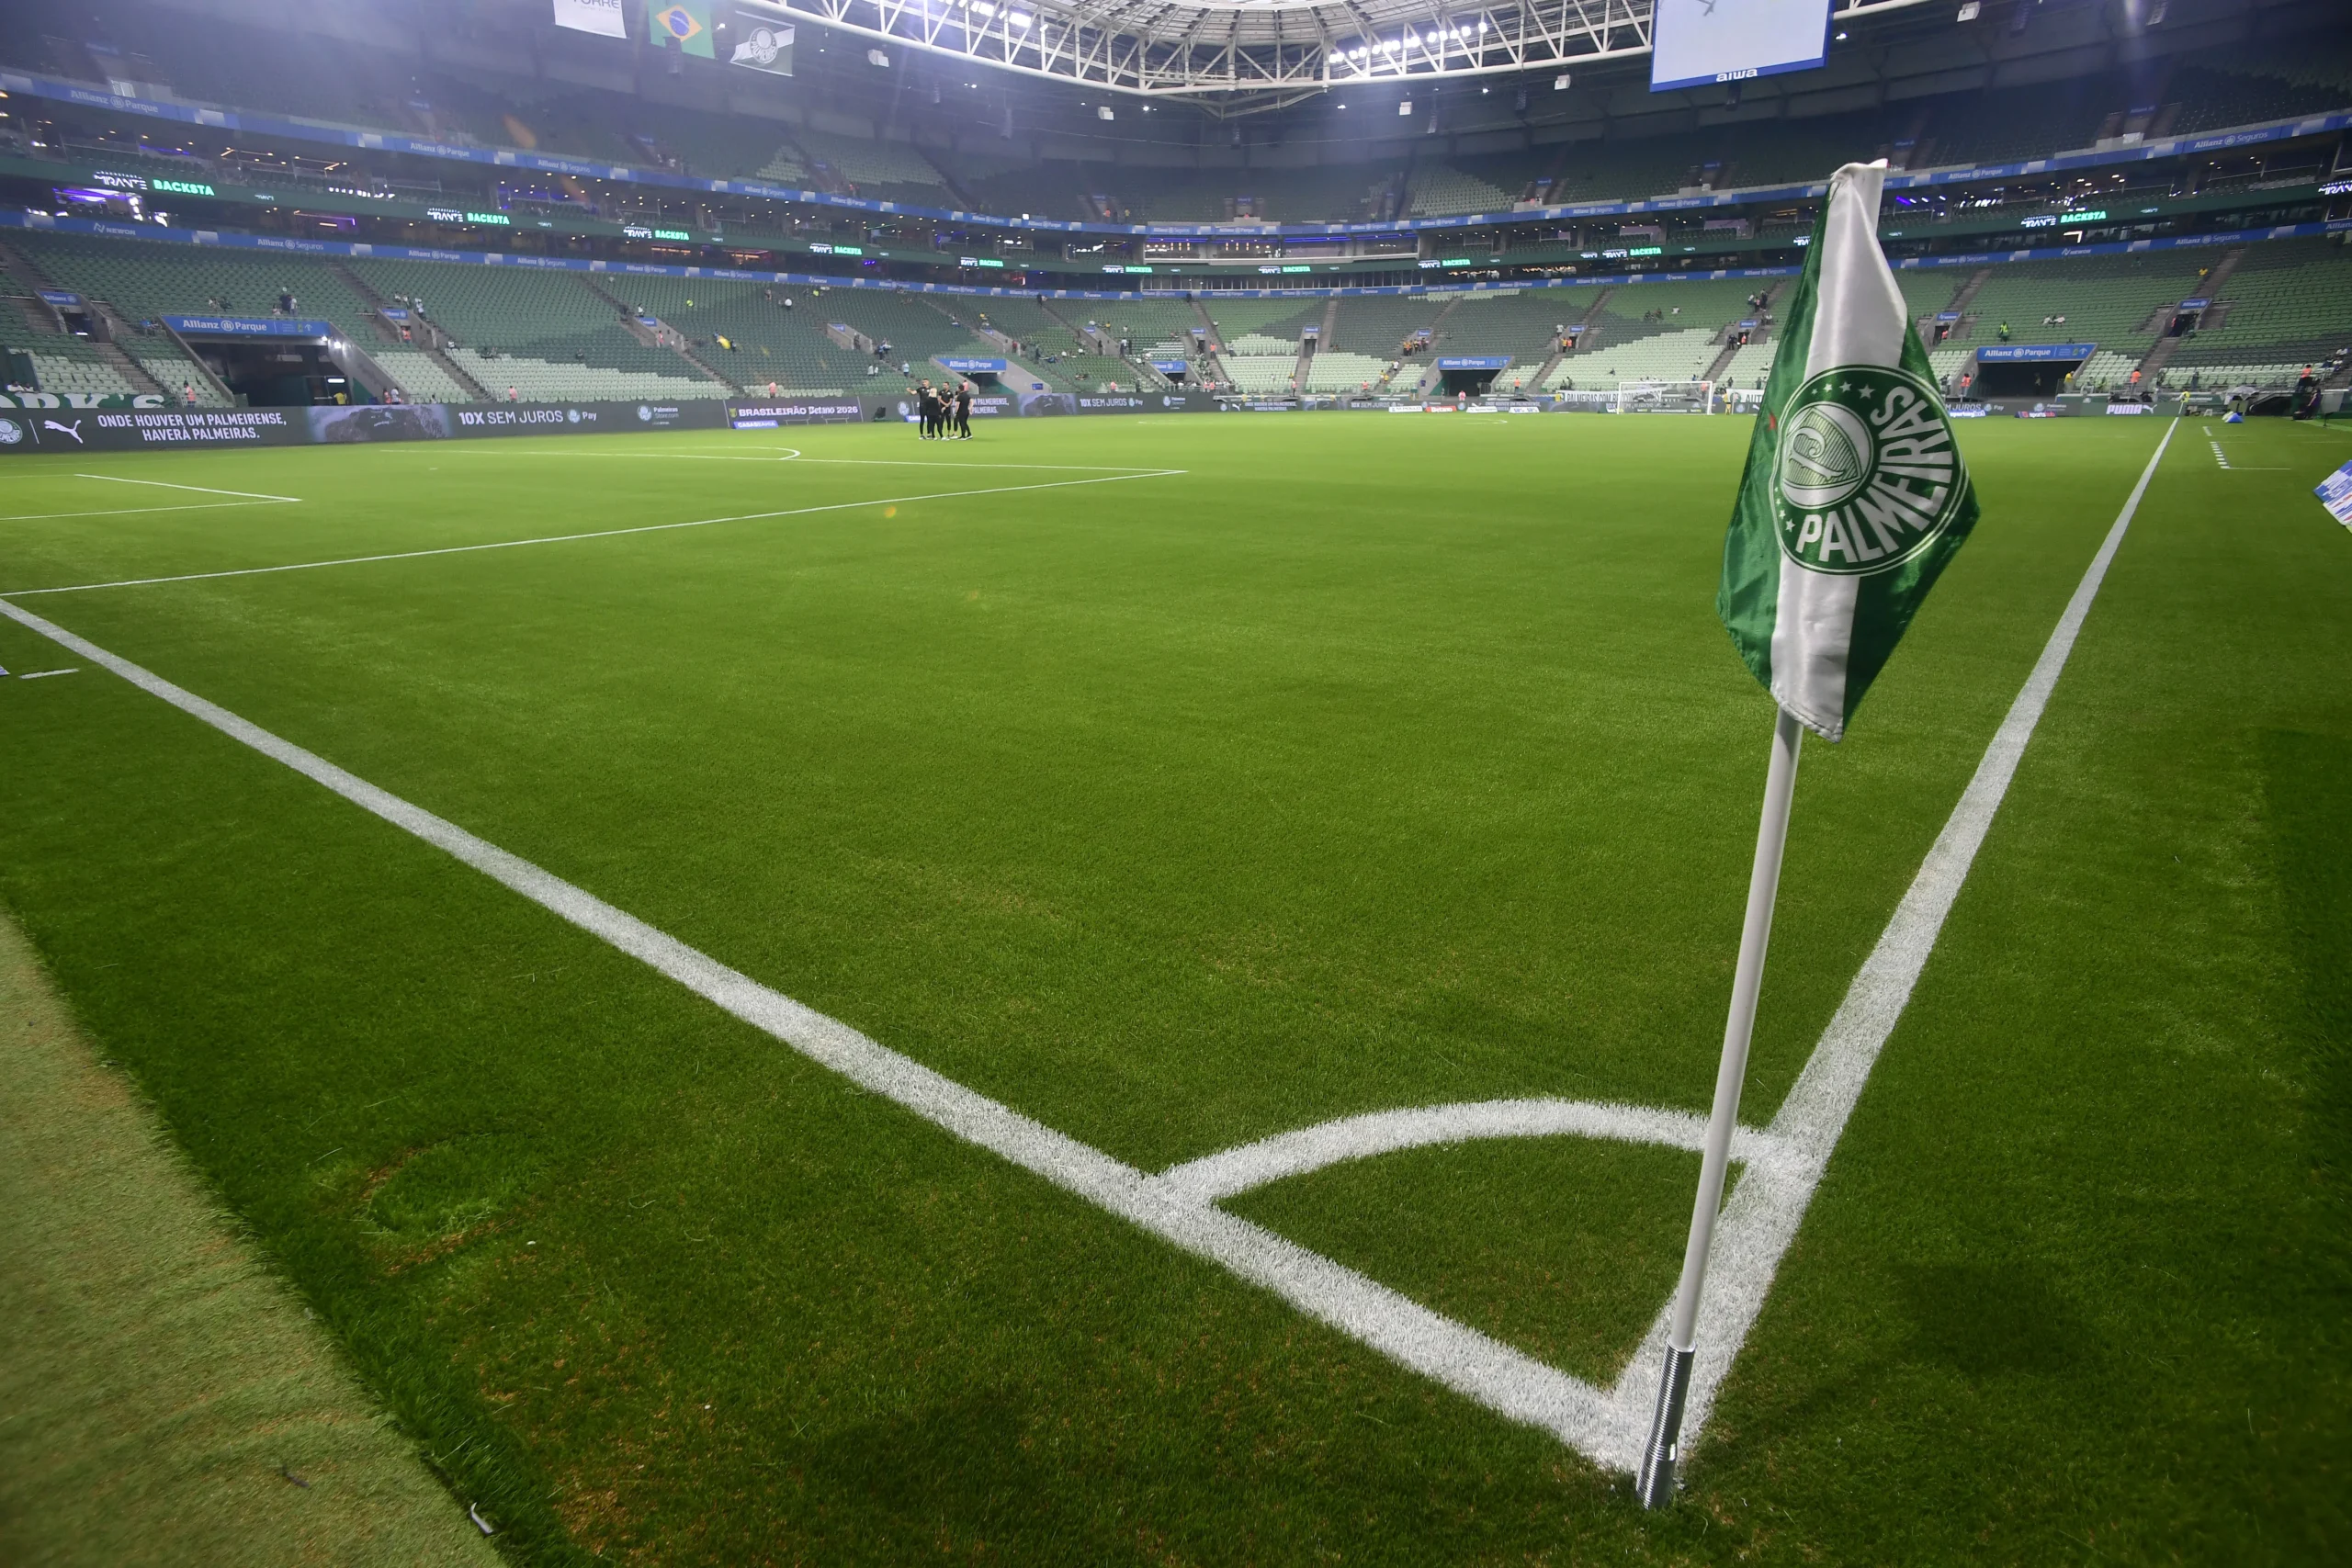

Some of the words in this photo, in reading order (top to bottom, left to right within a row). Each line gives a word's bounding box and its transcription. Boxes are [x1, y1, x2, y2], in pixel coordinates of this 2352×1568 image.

[1715, 68, 1758, 83] aiwa
[71, 89, 108, 105] Allianz
[125, 100, 159, 114] Parque
[2194, 138, 2223, 149] Allianz
[2235, 131, 2268, 143] Seguros
[411, 142, 436, 152] Allianz
[447, 147, 470, 158] Parque
[1948, 172, 1971, 180] Allianz
[1981, 168, 2003, 176] Parque
[153, 179, 215, 196] BACKSTA
[467, 212, 510, 225] BACKSTA
[2060, 211, 2107, 224] BACKSTA
[257, 238, 284, 247] Allianz
[296, 242, 324, 251] Seguros
[2175, 237, 2200, 246] Allianz
[2211, 233, 2240, 243] Seguros
[408, 250, 431, 258] Allianz
[517, 257, 538, 265] Allianz
[182, 319, 220, 331] Allianz
[234, 322, 267, 333] Parque
[1984, 349, 2012, 357] Allianz
[2024, 348, 2051, 357] Parque
[949, 360, 967, 368] Allianz
[975, 360, 992, 369] Parque
[1080, 399, 1091, 407] 10X
[1091, 399, 1105, 407] SEM
[1106, 399, 1127, 407] JUROS
[2106, 404, 2143, 414] PUMA
[458, 412, 485, 425] 10X
[488, 411, 516, 424] SEM
[519, 410, 563, 423] JUROS
[582, 412, 597, 421] Pay
[739, 405, 807, 417] BRASILEIRÃO
[808, 406, 835, 415] Betano
[836, 406, 859, 414] 2026
[97, 414, 133, 428] ONDE
[135, 414, 184, 427] HOUVER
[187, 414, 205, 426] UM
[207, 412, 288, 426] PALMEIRENSE,
[142, 425, 189, 442] HAVERÁ
[193, 426, 260, 441] PALMEIRAS.
[1794, 385, 1953, 564] PALMEIRAS
